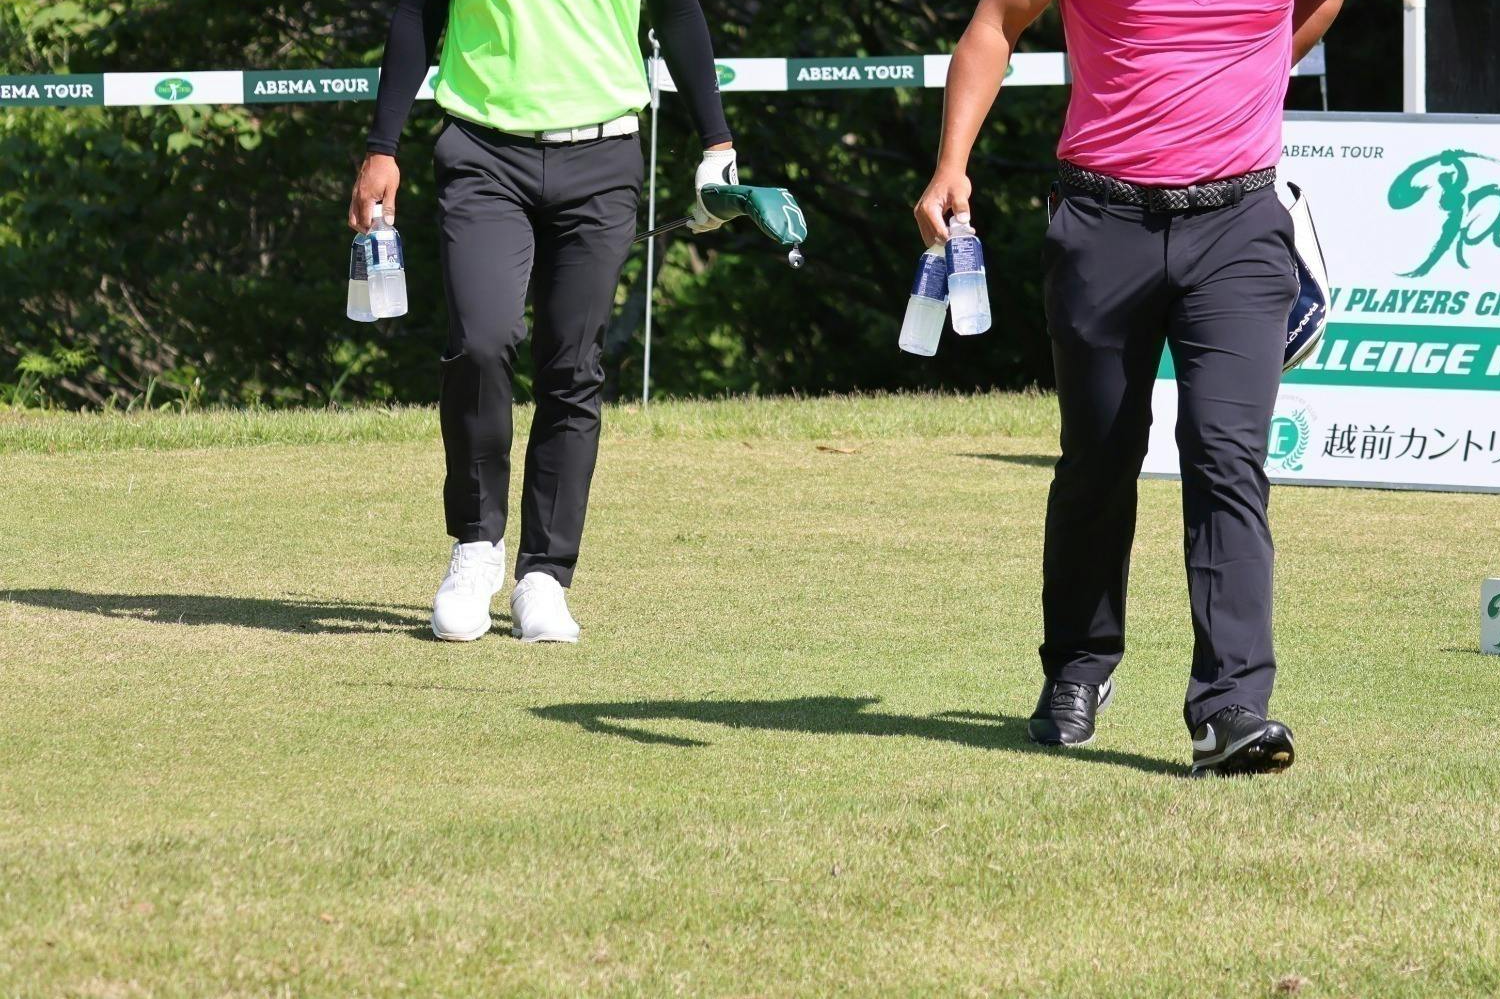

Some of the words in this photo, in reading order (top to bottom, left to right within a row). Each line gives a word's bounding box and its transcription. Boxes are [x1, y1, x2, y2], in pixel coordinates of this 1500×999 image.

[797, 67, 861, 82] ABEMA
[865, 65, 914, 80] TOUR
[1, 84, 40, 99] EMA
[44, 83, 94, 98] TOUR
[254, 79, 316, 95] ABEMA
[320, 78, 369, 94] TOUR
[1280, 145, 1335, 158] ABEMA
[1340, 146, 1384, 158] TOUR
[1345, 288, 1469, 315] PLAYERS
